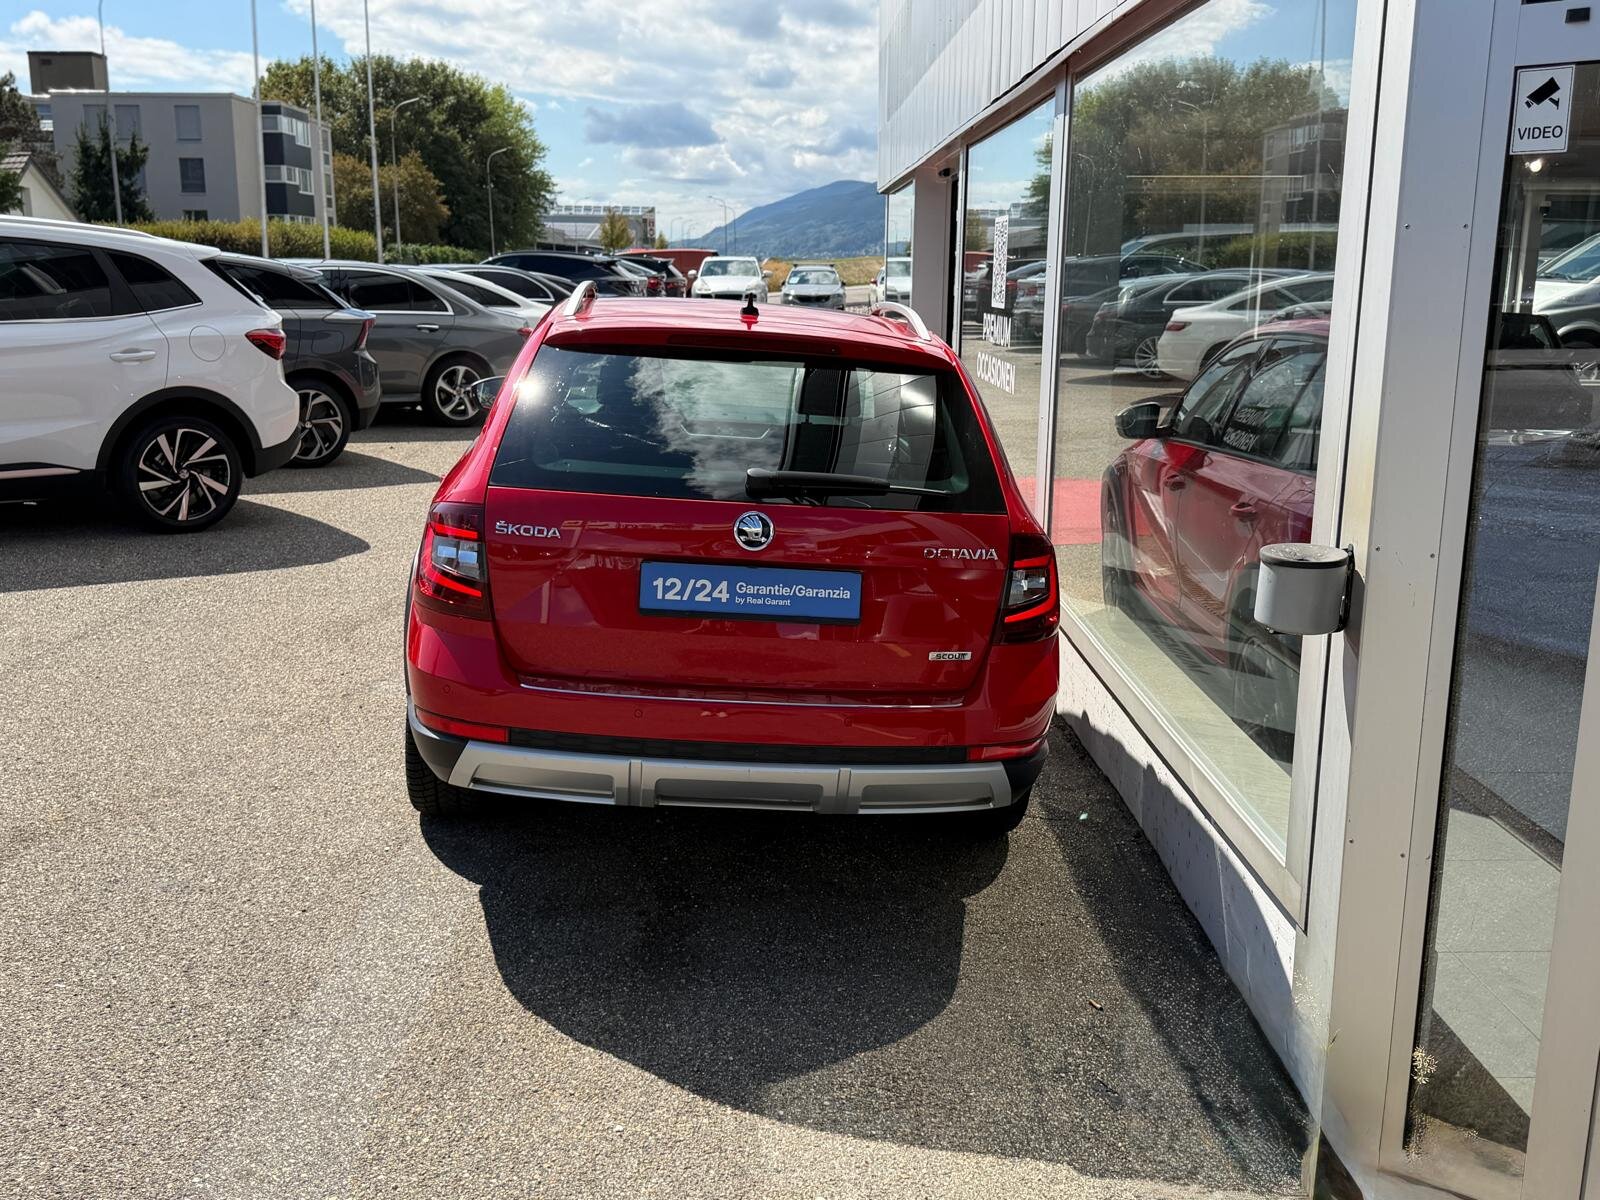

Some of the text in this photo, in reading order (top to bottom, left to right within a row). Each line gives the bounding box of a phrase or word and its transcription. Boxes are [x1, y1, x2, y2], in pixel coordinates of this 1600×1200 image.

[1517, 125, 1563, 140] VIDEO
[982, 312, 1012, 348] PREMIUM
[976, 351, 1016, 395] OCCASIONEN
[495, 520, 561, 539] ŠKODA
[923, 547, 999, 560] OCTAVIA
[652, 577, 730, 603] 12/24
[735, 581, 851, 599] Garantie/Garanzia
[735, 596, 791, 606] by Real Garant
[935, 652, 968, 660] SCOUT
